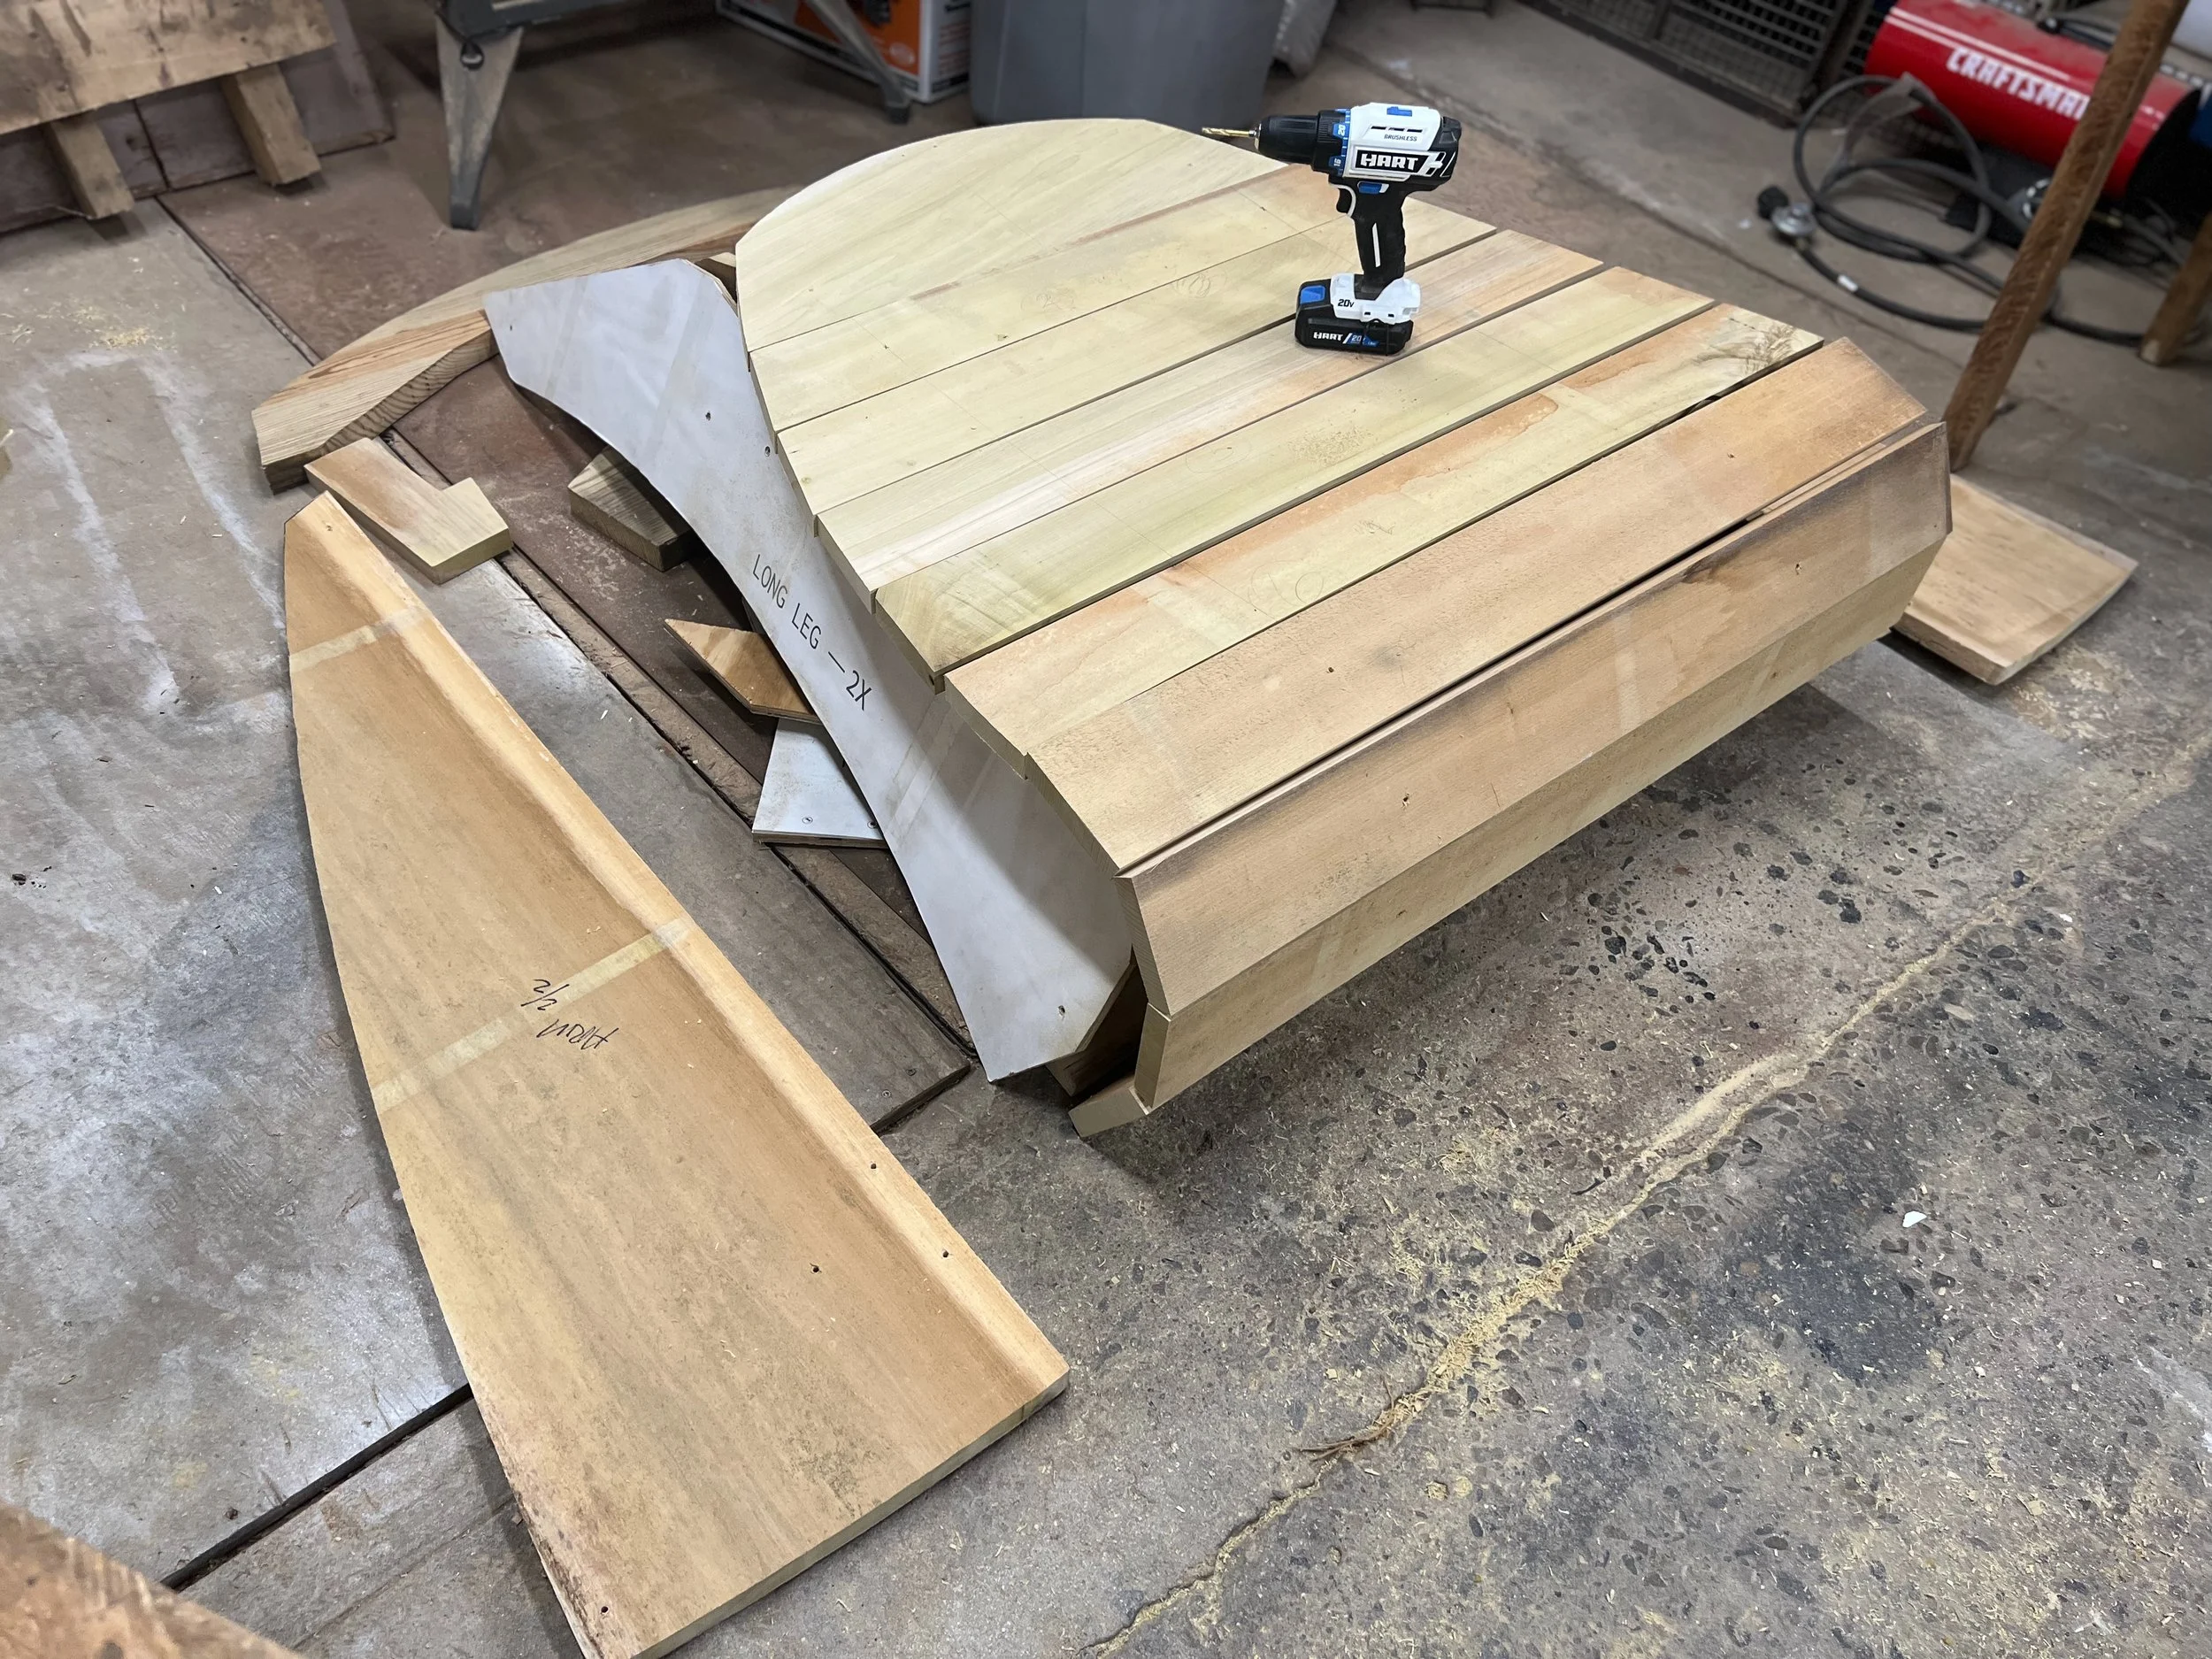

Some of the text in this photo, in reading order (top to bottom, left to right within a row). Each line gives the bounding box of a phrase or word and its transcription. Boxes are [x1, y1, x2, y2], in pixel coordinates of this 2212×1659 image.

[1360, 153, 1418, 171] HART
[1313, 332, 1343, 341] HART
[752, 554, 788, 609] LONG
[791, 603, 822, 649] LEG
